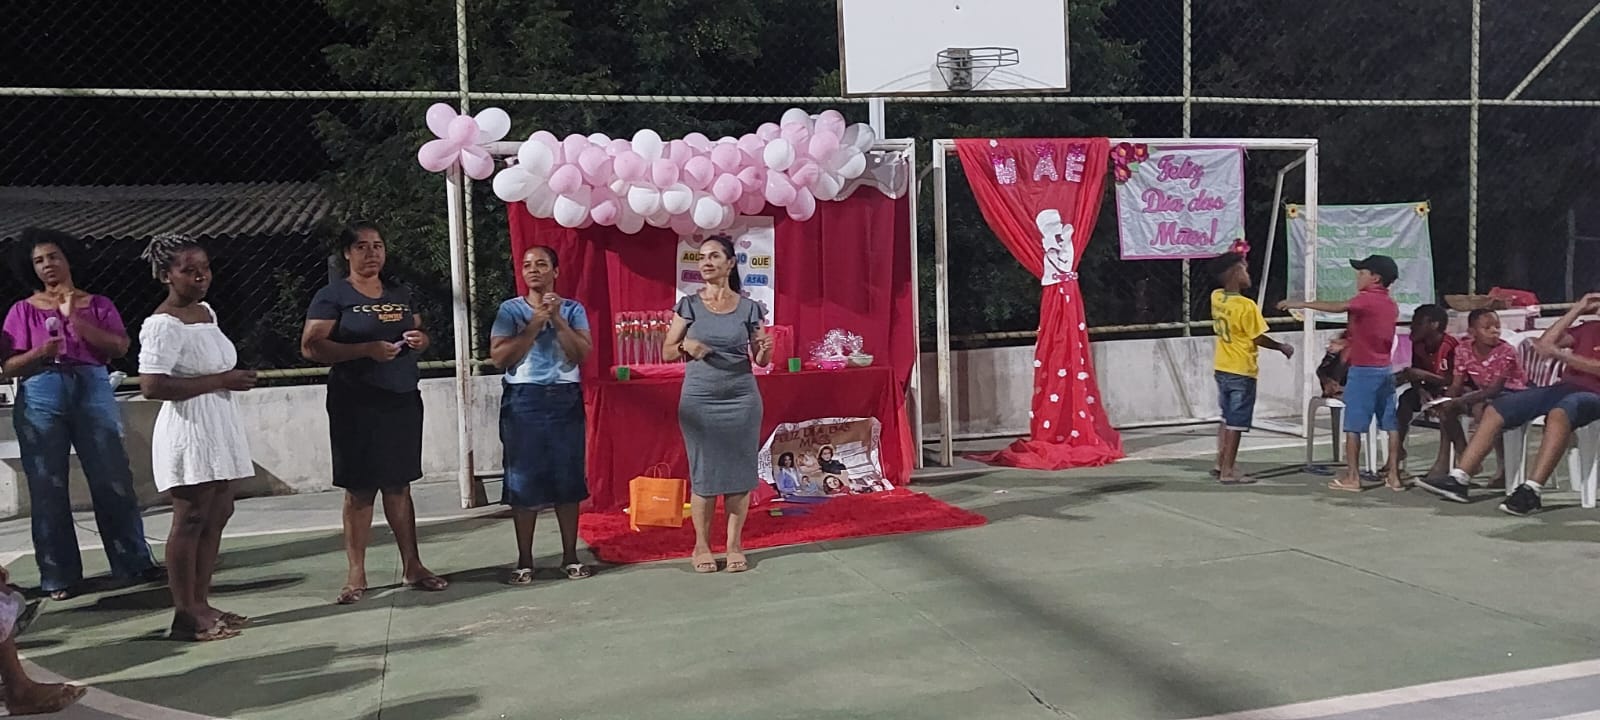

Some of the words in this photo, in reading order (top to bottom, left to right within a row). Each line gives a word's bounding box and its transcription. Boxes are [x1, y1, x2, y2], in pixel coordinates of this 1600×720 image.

[1157, 155, 1204, 189] Feliz
[1142, 188, 1184, 213] Dia
[1187, 189, 1225, 212] das
[1150, 218, 1218, 246] Mães!
[752, 257, 769, 266] QUE
